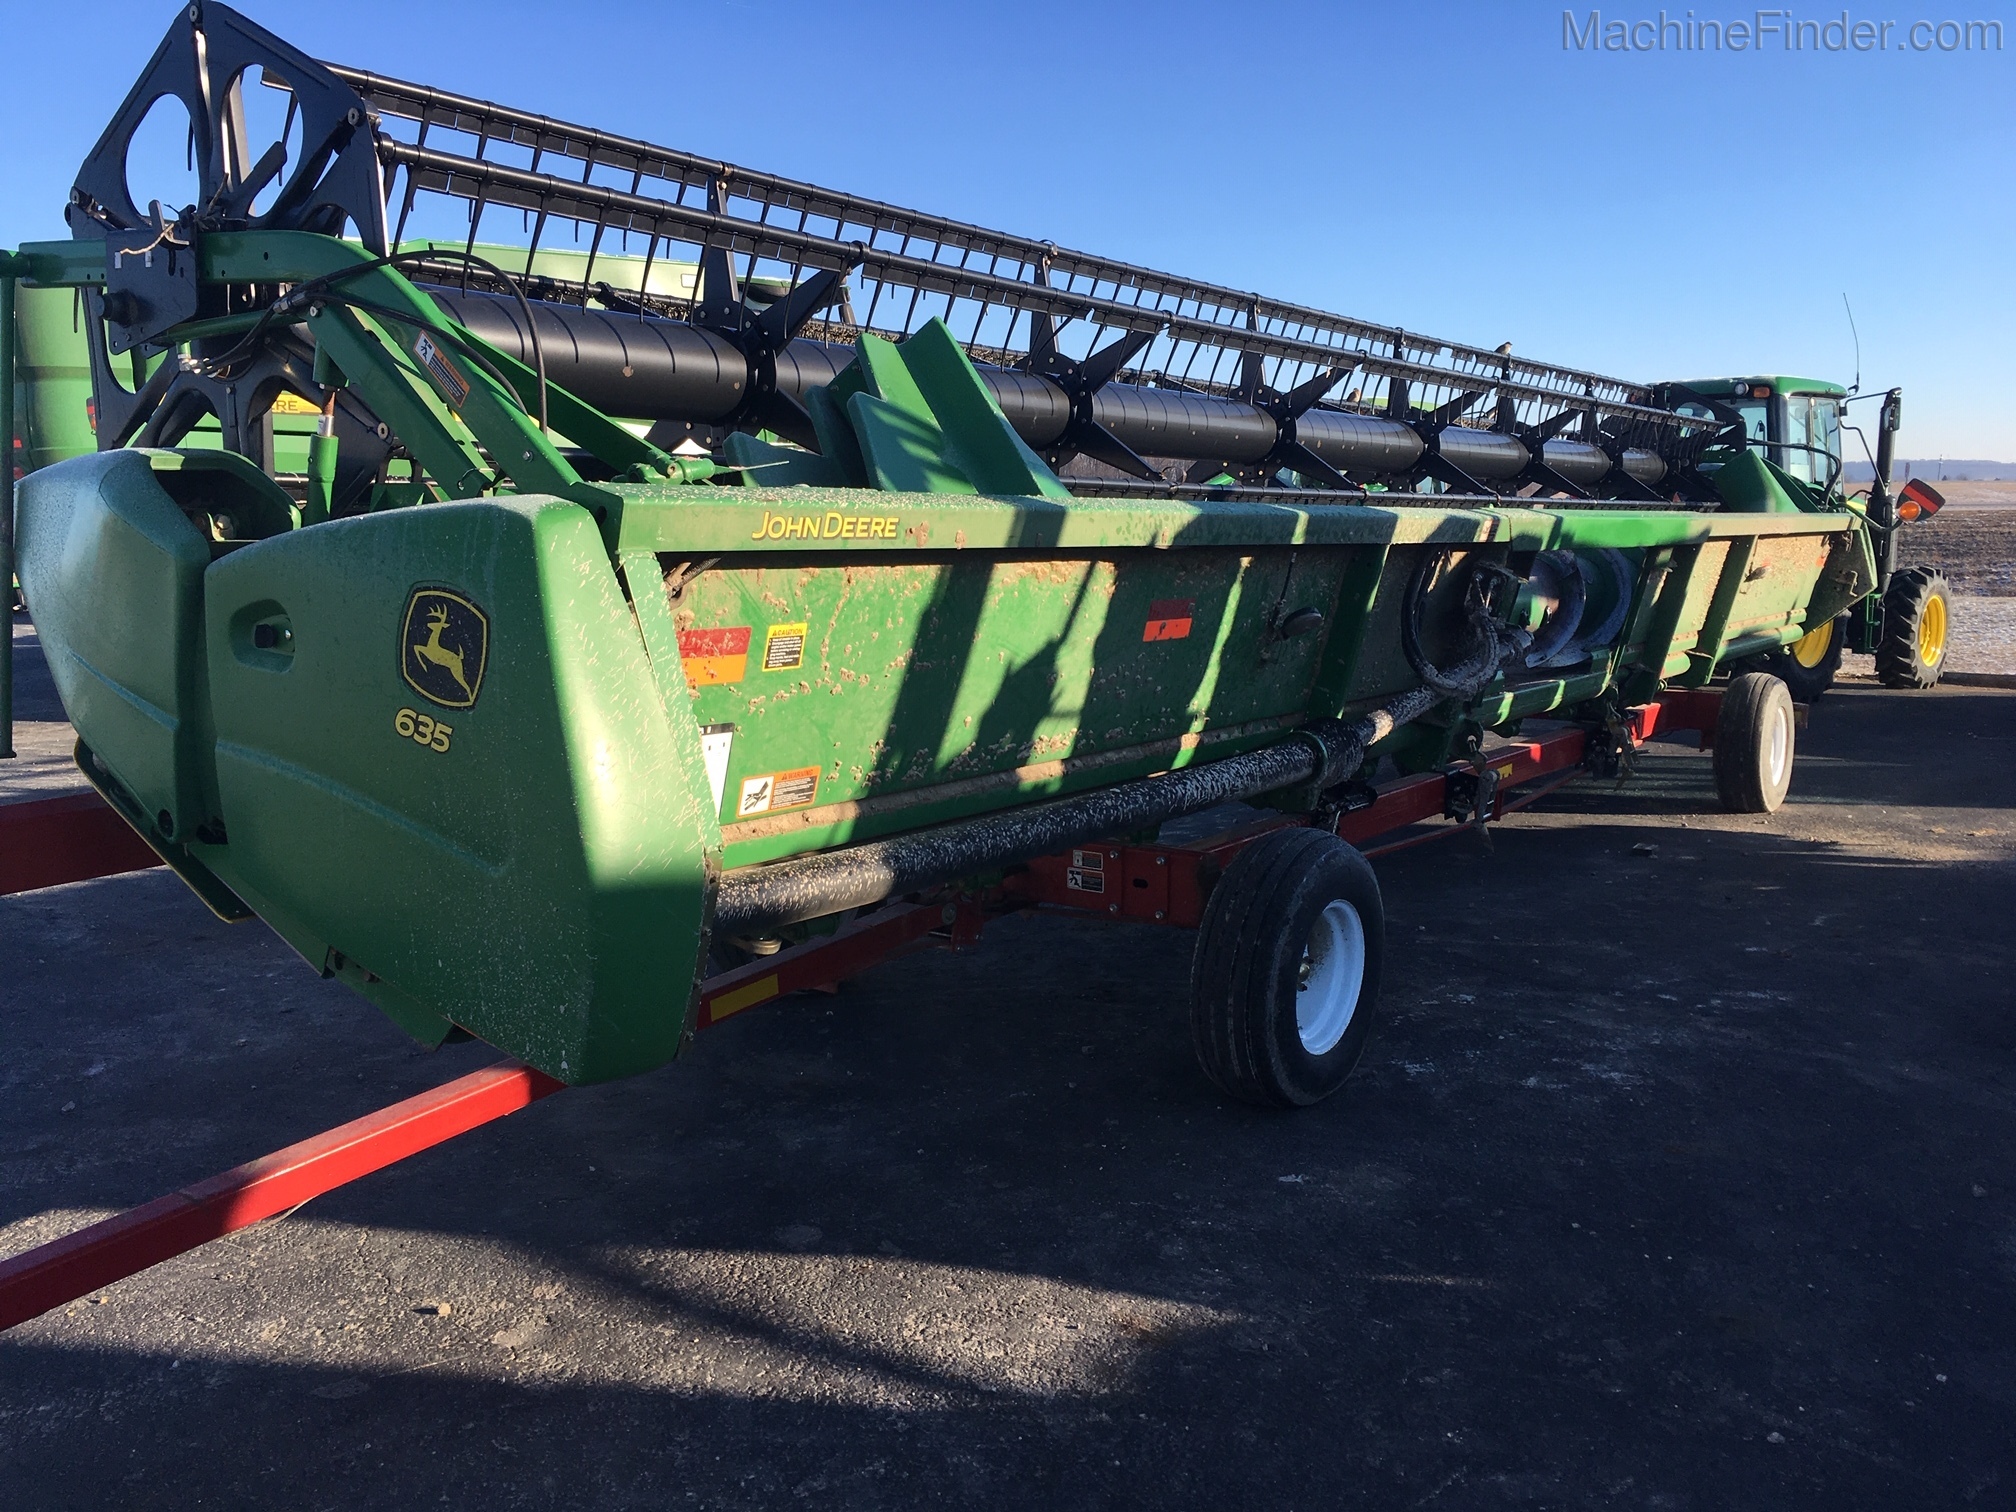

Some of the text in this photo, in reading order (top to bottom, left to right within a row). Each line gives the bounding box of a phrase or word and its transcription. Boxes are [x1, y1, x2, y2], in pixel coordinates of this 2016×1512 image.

[271, 400, 298, 411] RE
[752, 511, 899, 540] JOHN DEERE
[395, 708, 454, 752] 635
